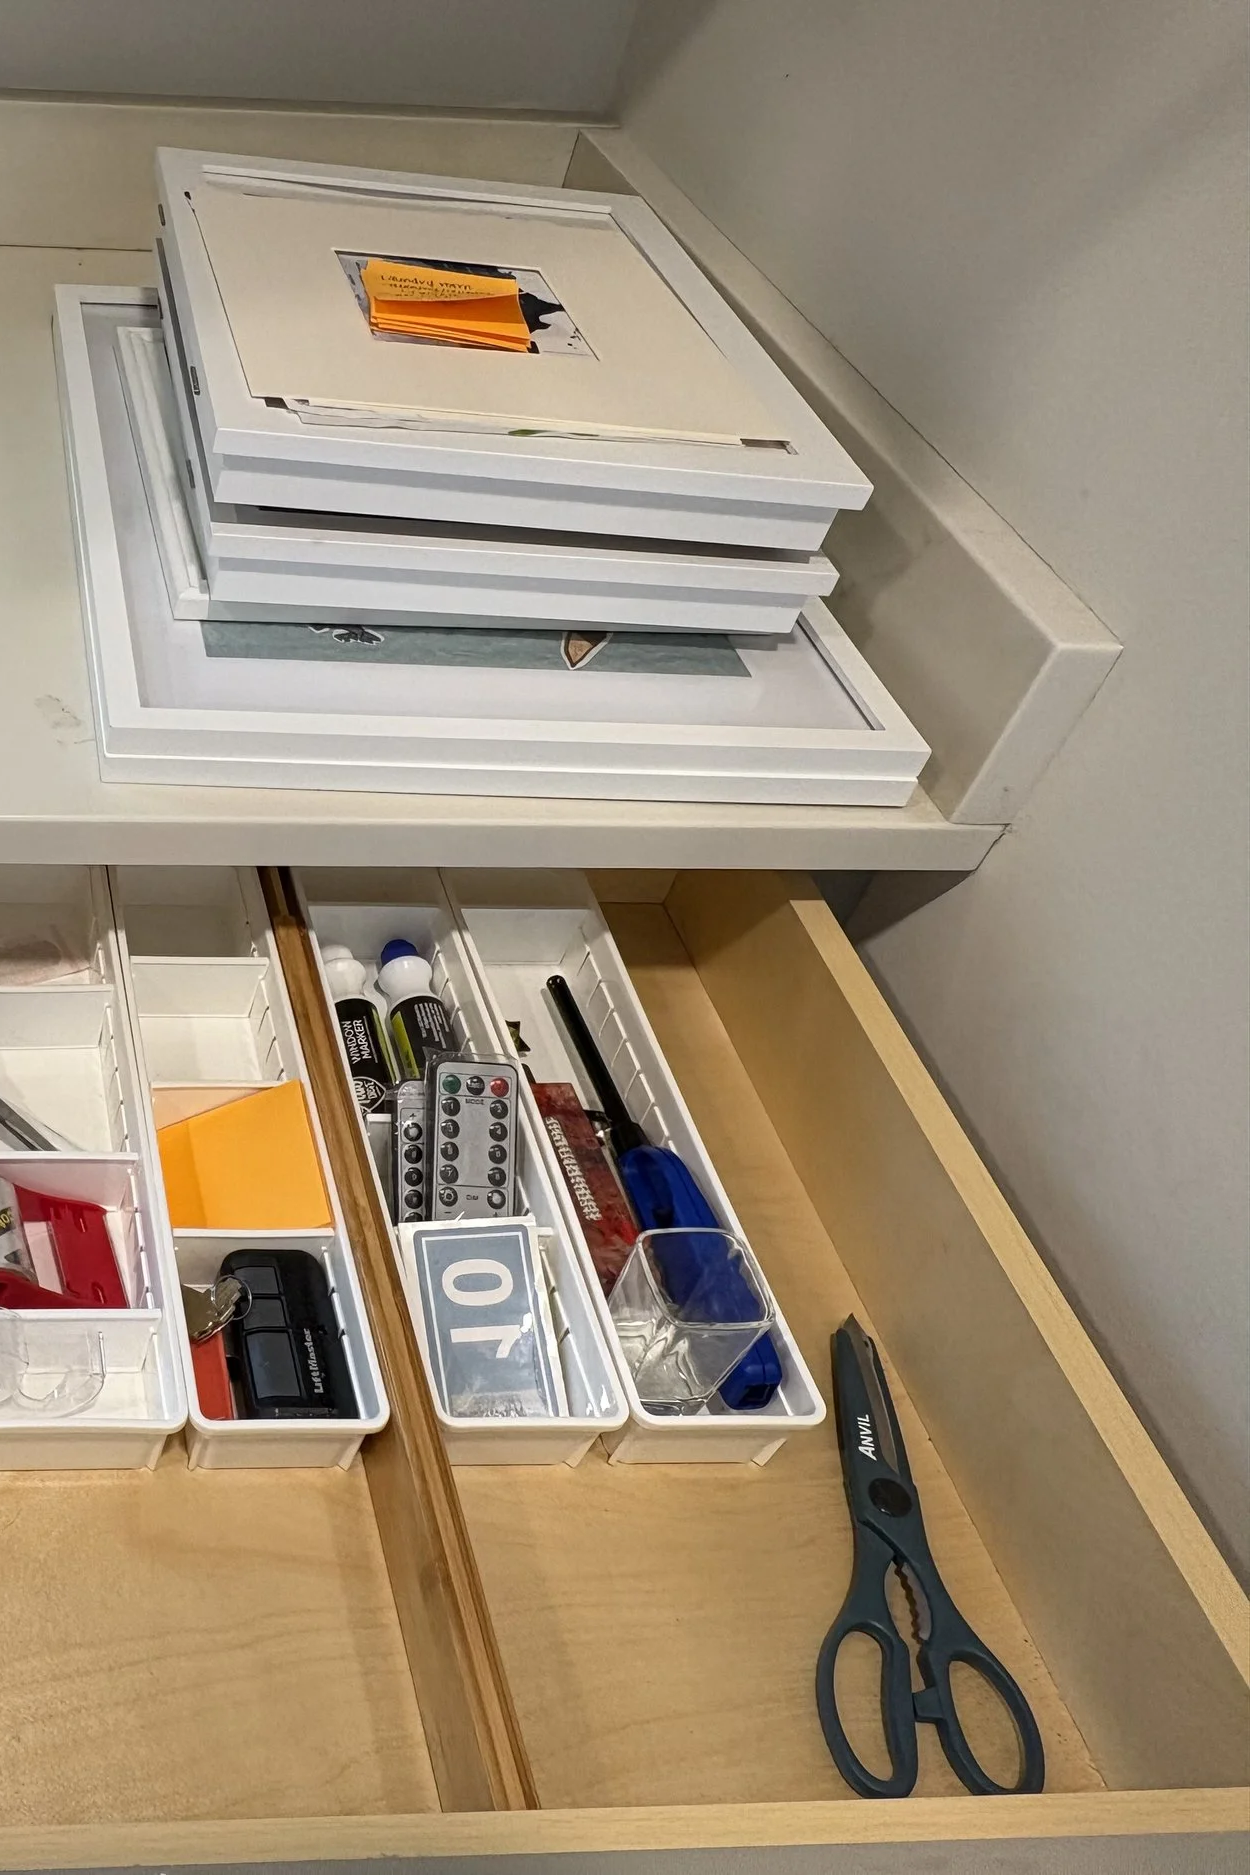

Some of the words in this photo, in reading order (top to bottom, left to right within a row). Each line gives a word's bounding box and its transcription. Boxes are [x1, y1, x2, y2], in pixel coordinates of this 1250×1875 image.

[342, 1020, 360, 1064] WINDOW
[353, 1019, 372, 1059] MARKER
[442, 1259, 521, 1359] 10
[303, 1328, 323, 1394] LiftMaster
[857, 1414, 877, 1460] ANVIL
